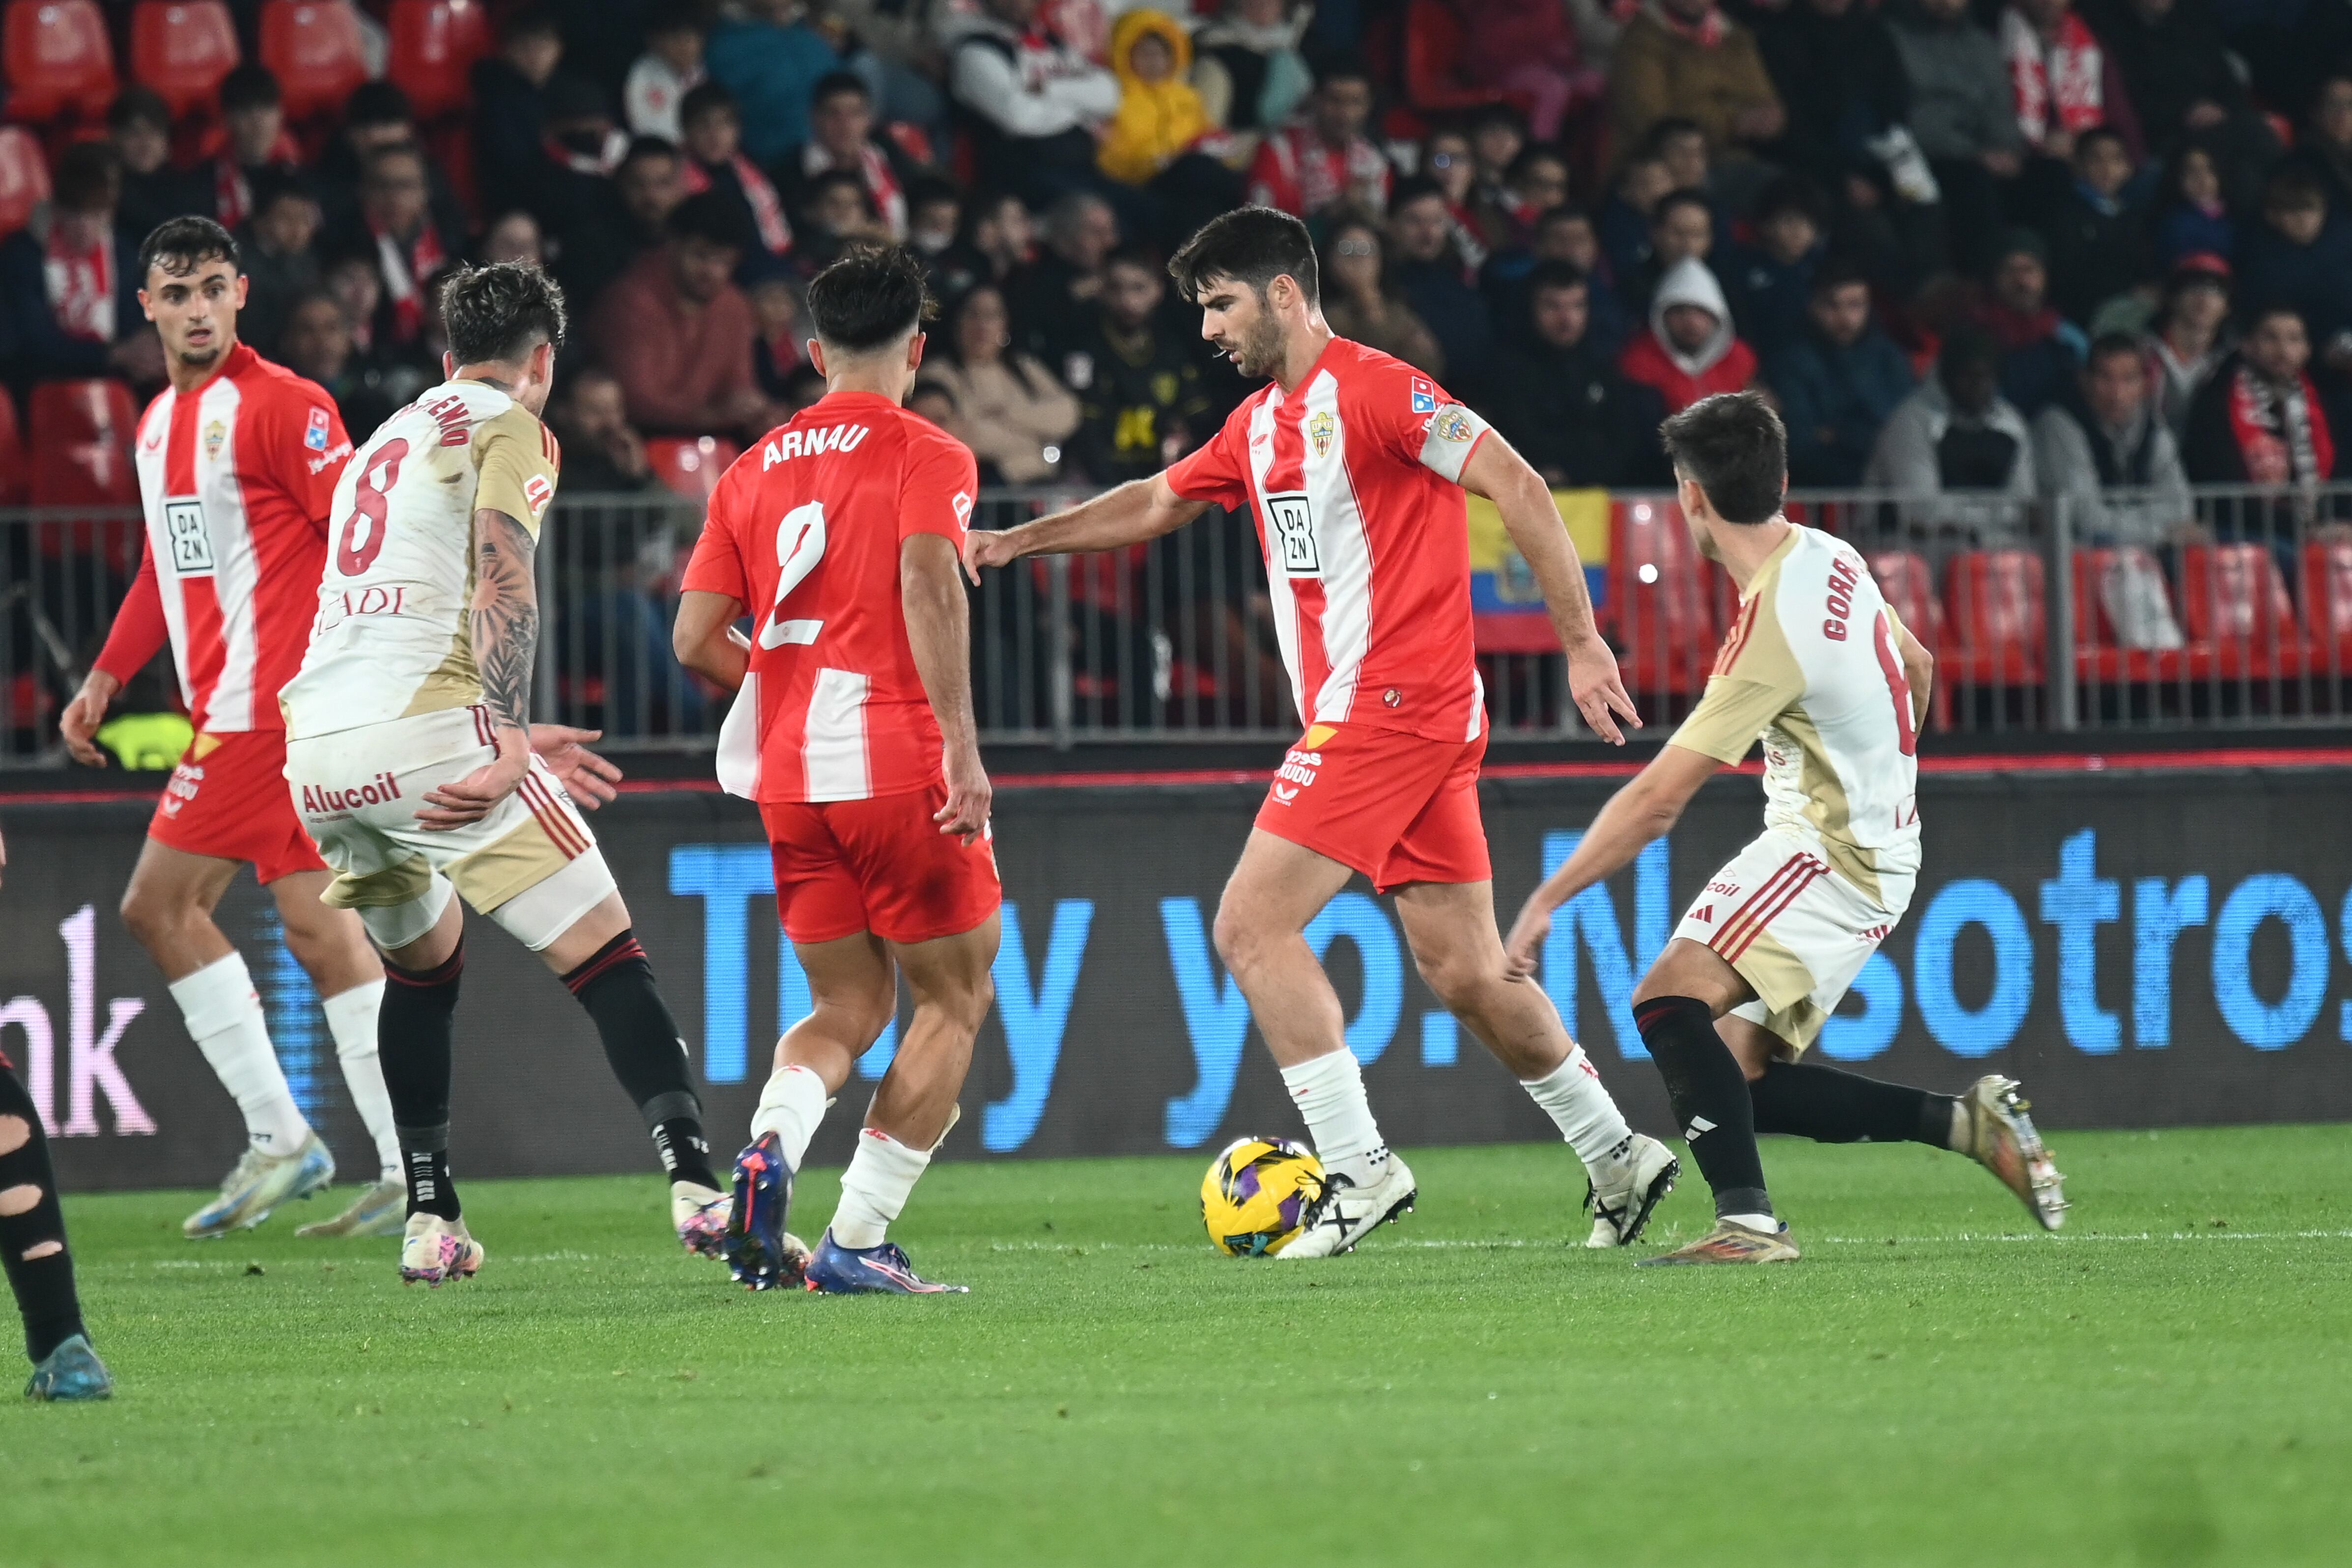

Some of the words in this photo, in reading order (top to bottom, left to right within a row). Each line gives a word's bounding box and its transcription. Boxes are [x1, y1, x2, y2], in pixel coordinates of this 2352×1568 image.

[763, 424, 869, 472] ARNAU
[178, 514, 198, 534] DA
[337, 437, 409, 576] 8
[1283, 509, 1304, 531] DA
[182, 540, 203, 561] ZN
[1290, 537, 1307, 560] ZN
[758, 499, 827, 651] 2
[303, 771, 402, 813] Alucoil
[981, 898, 1094, 1153] y
